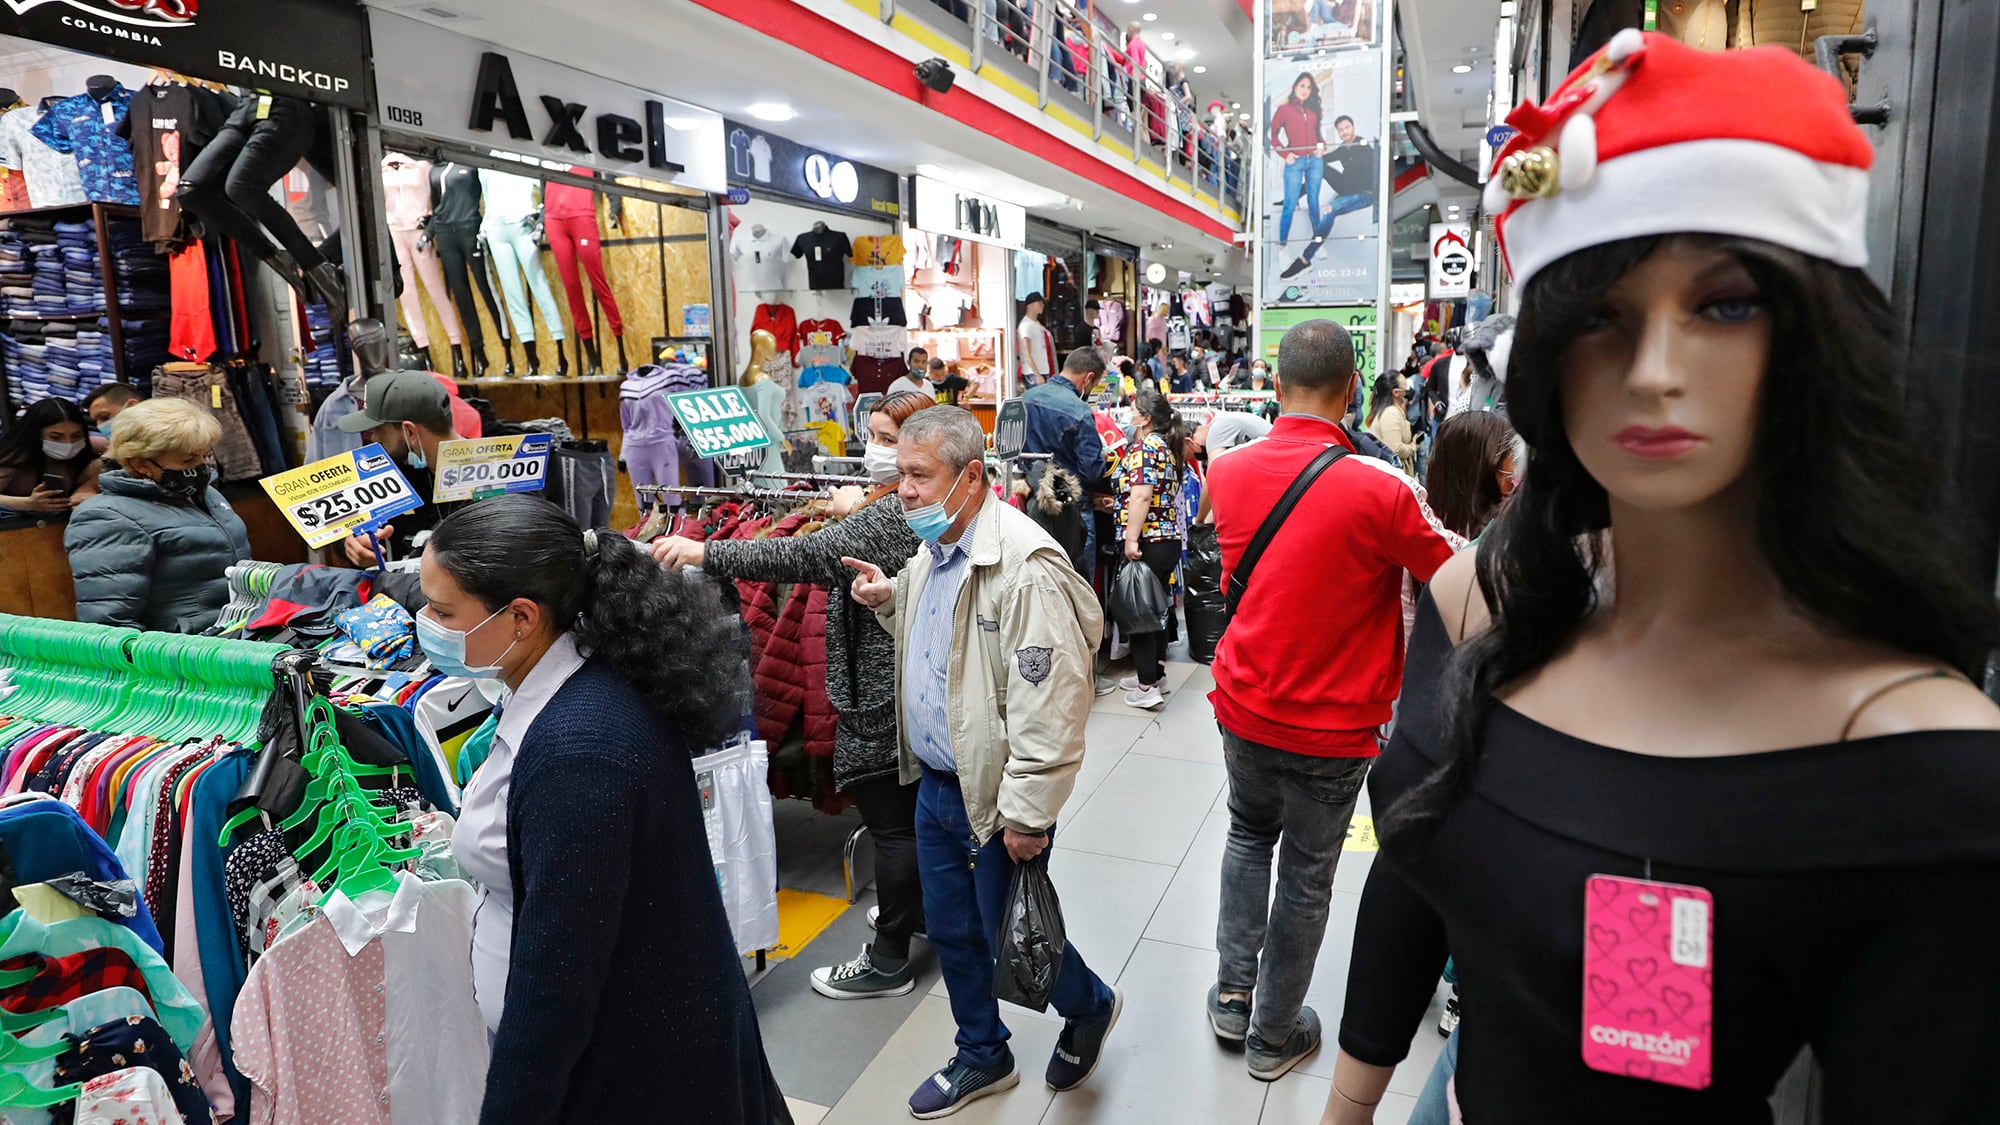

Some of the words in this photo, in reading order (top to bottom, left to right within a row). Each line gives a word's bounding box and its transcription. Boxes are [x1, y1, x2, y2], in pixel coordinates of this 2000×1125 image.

[61, 16, 162, 46] COLOMBIA
[218, 50, 349, 92] BANCKOP
[387, 105, 423, 127] 1098
[678, 392, 748, 424] SALE
[442, 447, 474, 458] GRAN
[476, 443, 513, 454] OFERTA
[693, 421, 764, 452] $55.000
[274, 475, 310, 496] GRAN
[310, 464, 352, 484] OFERTA
[443, 460, 540, 488] $20.000
[297, 476, 401, 528] $25.000
[1589, 1024, 1691, 1059] corazón
